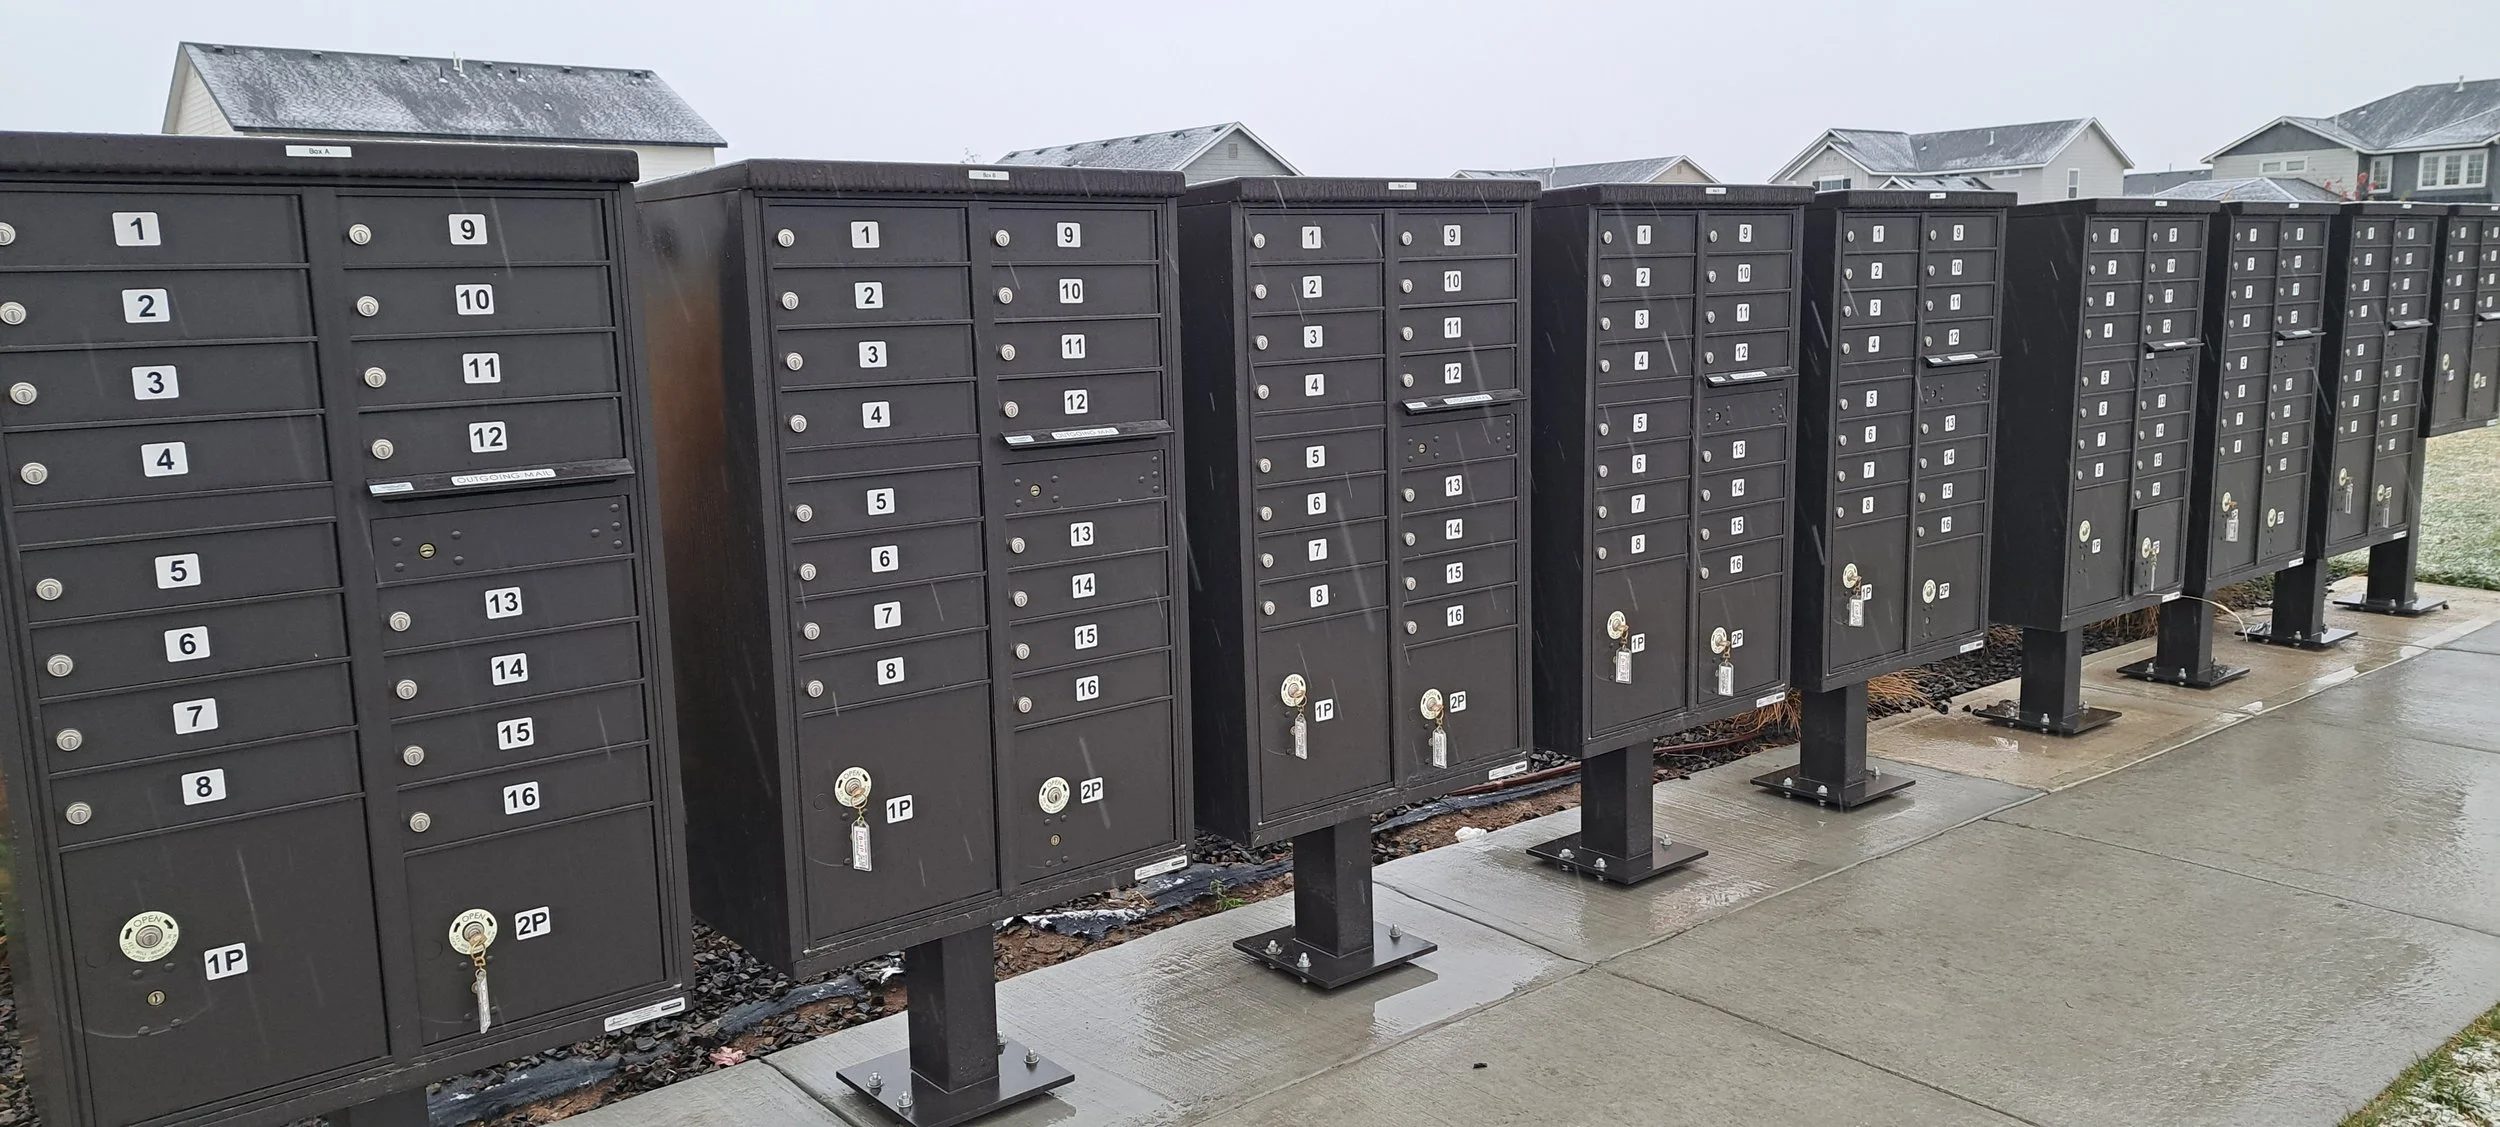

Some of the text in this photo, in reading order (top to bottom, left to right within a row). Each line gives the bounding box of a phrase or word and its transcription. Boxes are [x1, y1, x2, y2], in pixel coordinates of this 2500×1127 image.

[130, 217, 144, 241] 1
[460, 219, 476, 241] 9
[861, 225, 870, 244] 1
[1064, 226, 1074, 244] 9
[1449, 228, 1456, 243] 9
[1642, 228, 1646, 241] 1
[1743, 227, 1748, 239] 9
[1877, 228, 1880, 239] 1
[1956, 227, 1961, 238] 9
[1309, 230, 1314, 245] 1
[1740, 267, 1749, 279] 10
[1874, 265, 1879, 276] 2
[1954, 262, 1961, 272] 10
[2110, 262, 2115, 273] 2
[1446, 274, 1460, 288] 10
[1640, 271, 1646, 284] 2
[1062, 282, 1081, 300] 10
[1309, 280, 1317, 294] 2
[460, 289, 490, 310] 10
[864, 286, 875, 305] 2
[1952, 296, 1959, 307] 11
[137, 294, 157, 318] 2
[1739, 306, 1748, 318] 11
[1873, 302, 1878, 313] 3
[1639, 313, 1645, 326] 3
[1447, 320, 1459, 334] 11
[1310, 329, 1317, 344] 3
[1950, 332, 1958, 342] 12
[1065, 338, 1082, 355] 11
[1872, 339, 1876, 349] 4
[868, 345, 879, 364] 3
[1737, 346, 1746, 358] 12
[468, 357, 496, 378] 11
[1638, 355, 1644, 367] 4
[1446, 366, 1460, 380] 12
[2103, 373, 2107, 383] 5
[146, 371, 165, 394] 3
[1311, 378, 1319, 392] 4
[1067, 393, 1085, 410] 12
[1870, 393, 1874, 404] 5
[870, 406, 882, 423] 4
[1637, 416, 1643, 429] 5
[1947, 418, 1954, 428] 13
[473, 426, 504, 448] 12
[1055, 430, 1096, 439] OUTGOING
[1868, 429, 1873, 440] 6
[2099, 434, 2104, 445] 7
[1734, 443, 1744, 455] 13
[156, 448, 175, 470] 4
[1312, 449, 1319, 464] 5
[1636, 457, 1642, 470] 6
[1945, 452, 1953, 461] 14
[1867, 464, 1872, 475] 7
[455, 470, 553, 484] OUTGOING MAIL
[1448, 478, 1461, 492] 13
[1734, 482, 1743, 494] 14
[1944, 485, 1951, 496] 15
[876, 492, 887, 510] 5
[1313, 496, 1321, 511] 6
[1636, 498, 1641, 510] 7
[1866, 500, 1870, 510] 8
[1448, 522, 1461, 536] 14
[1733, 519, 1742, 531] 15
[1943, 519, 1950, 529] 16
[1073, 526, 1091, 542] 13
[1314, 543, 1321, 557] 7
[1635, 538, 1641, 550] 8
[879, 550, 890, 567] 6
[1732, 558, 1741, 570] 16
[170, 559, 188, 582] 5
[1448, 565, 1462, 580] 15
[1075, 577, 1093, 594] 14
[1940, 585, 1948, 596] 2P
[489, 592, 519, 614] 13
[1316, 589, 1323, 603] 8
[882, 607, 893, 624] 7
[1449, 608, 1462, 623] 16
[179, 632, 197, 655] 6
[1077, 628, 1095, 645] 15
[1633, 636, 1644, 649] 1P
[1732, 632, 1742, 645] 2P
[495, 658, 525, 680] 14
[886, 662, 897, 680] 8
[1078, 679, 1097, 697] 16
[1451, 694, 1465, 709] 2P
[186, 704, 203, 728] 7
[1316, 702, 1332, 718] 1P
[501, 722, 530, 744] 15
[843, 769, 862, 780] OPEN
[196, 776, 213, 798] 8
[1046, 779, 1062, 788] OPEN
[1082, 781, 1101, 800] 2P
[507, 786, 536, 809] 16
[888, 799, 911, 819] 1P
[133, 915, 162, 927] OPEN
[462, 911, 486, 923] OPEN
[517, 911, 548, 936] 2P
[207, 948, 244, 975] 1P
